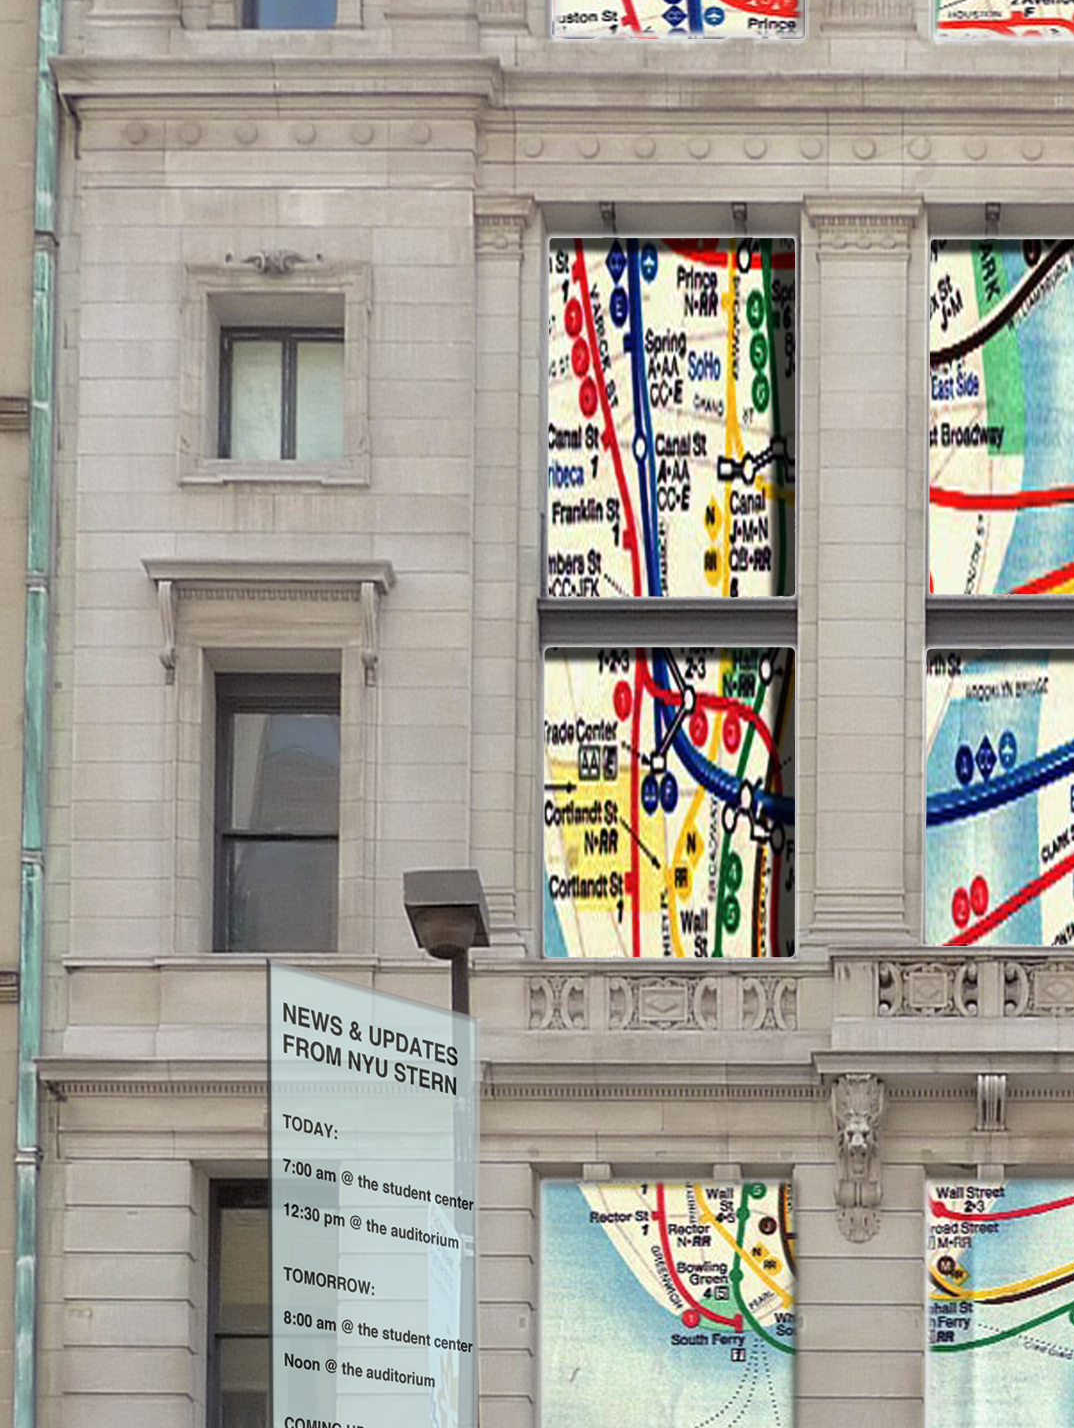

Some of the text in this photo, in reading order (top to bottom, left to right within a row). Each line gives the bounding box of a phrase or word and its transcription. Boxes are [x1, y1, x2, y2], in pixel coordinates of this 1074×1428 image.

[748, 18, 796, 30] Prince
[645, 329, 687, 359] Spring
[688, 352, 721, 381] SoHo
[956, 370, 979, 397] Side
[656, 434, 691, 459] Canal
[941, 424, 1004, 449] Broadway
[552, 500, 603, 524] Franklin
[729, 489, 766, 516] Canal
[544, 800, 618, 826] Cortlandt St
[549, 872, 623, 900] Cortlandt St
[680, 910, 708, 934] Wall
[283, 1002, 458, 1066] NEWS & UPDATES
[283, 1034, 457, 1095] FROM NYU STERN
[283, 1114, 338, 1139] TODAY:
[283, 1158, 474, 1211] 7:00 am @ the student center
[706, 1188, 734, 1199] Wall
[936, 1186, 1005, 1199] Wall Street
[284, 1202, 459, 1249] 12:30 pm @ the auditorium
[590, 1211, 649, 1223] Rector St
[668, 1224, 710, 1235] Rector
[677, 1262, 728, 1274] Bowling
[690, 1274, 729, 1285] Green
[283, 1267, 375, 1295] TOMORROW:
[283, 1311, 473, 1353] 8:00 am @ the student center
[937, 1317, 971, 1330] Ferry
[671, 1334, 745, 1348] South Ferry
[284, 1353, 436, 1387] Noon @ the auditorium
